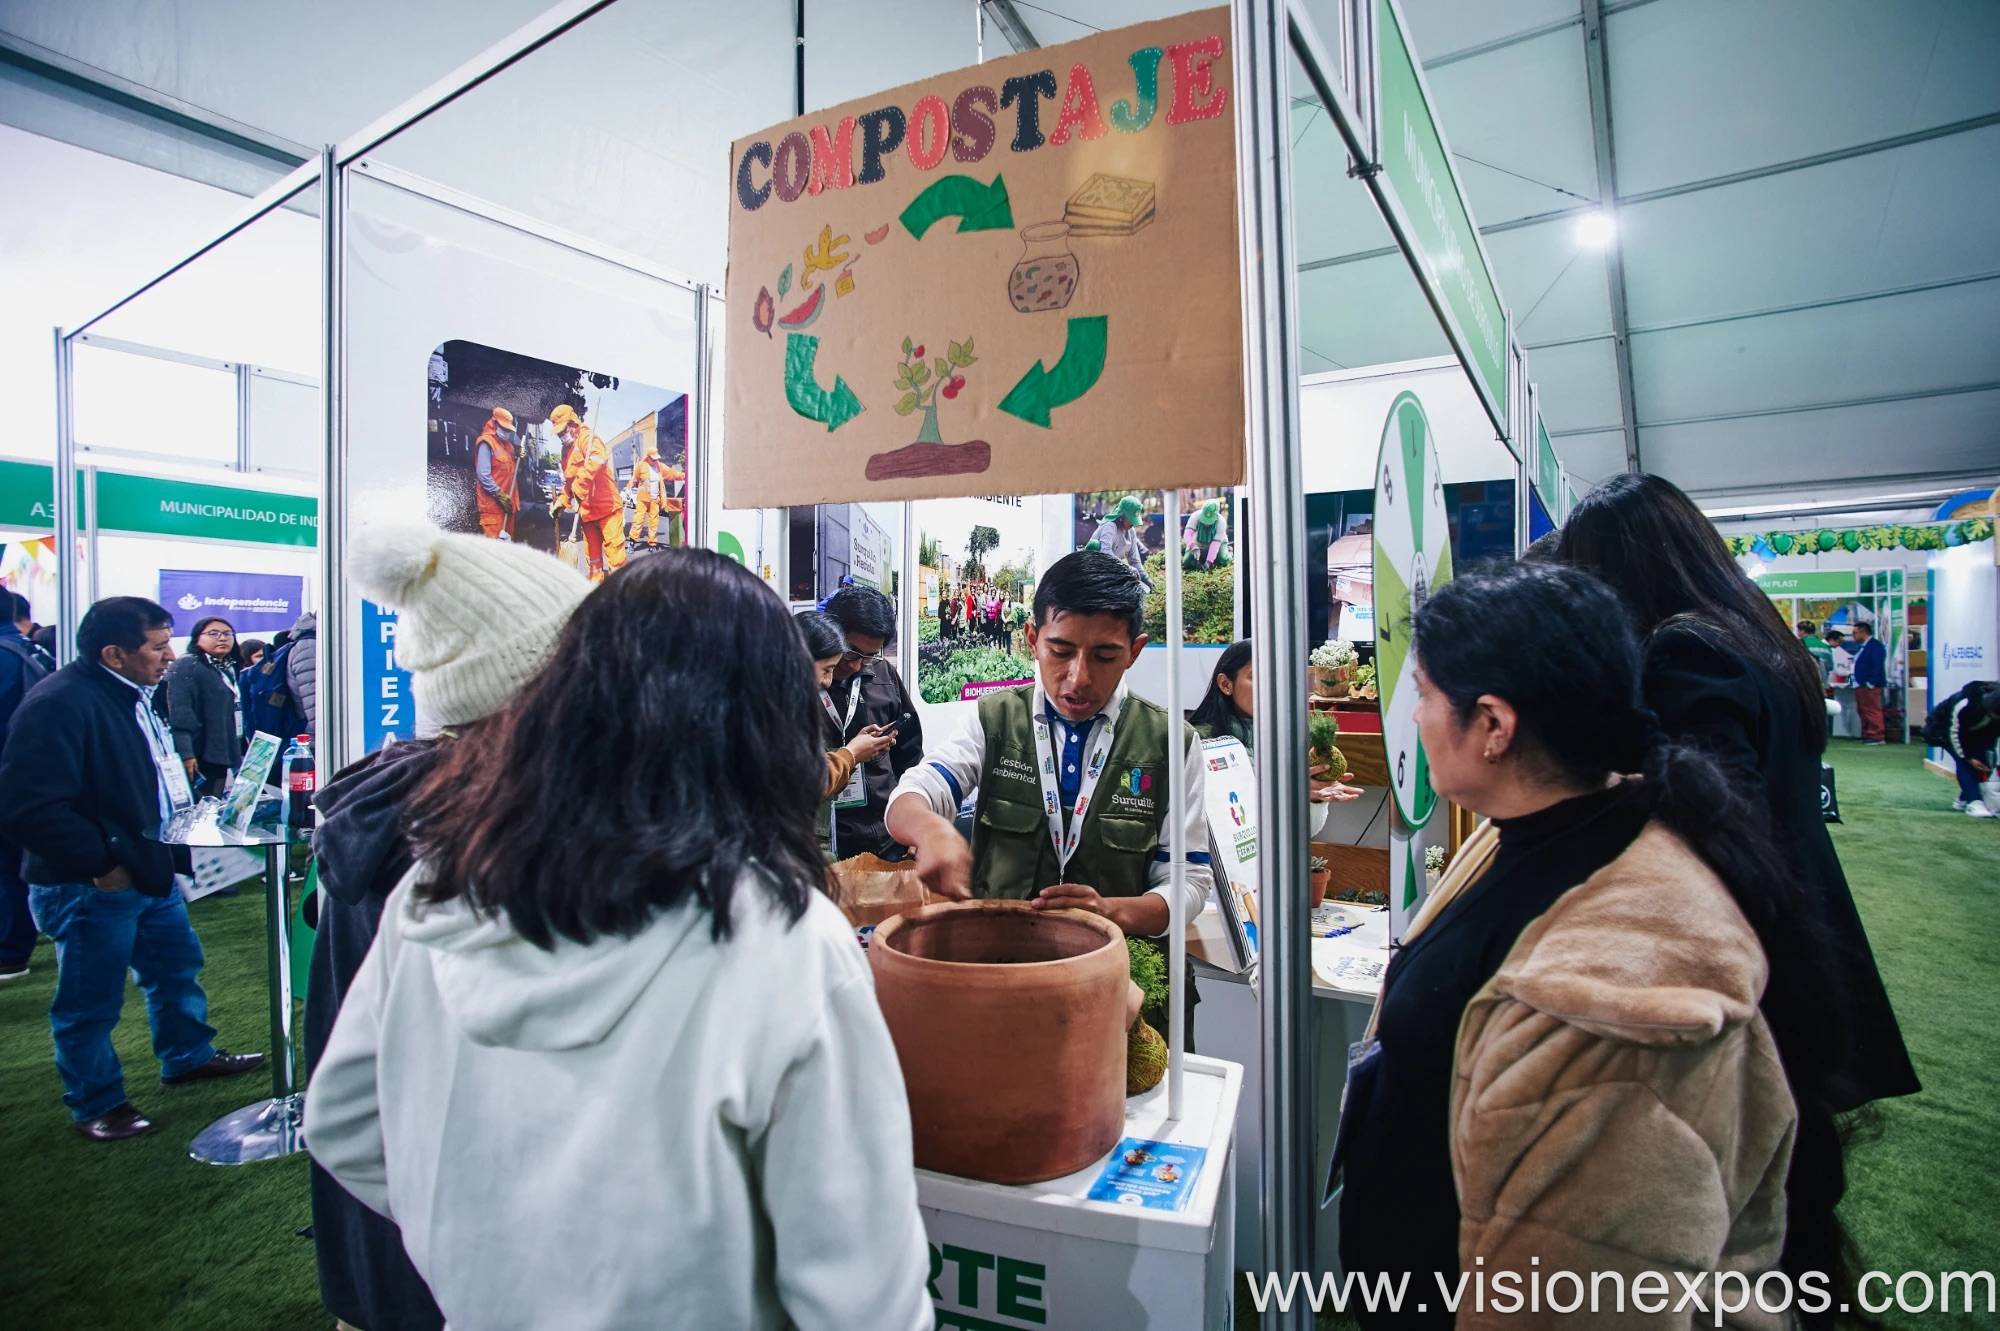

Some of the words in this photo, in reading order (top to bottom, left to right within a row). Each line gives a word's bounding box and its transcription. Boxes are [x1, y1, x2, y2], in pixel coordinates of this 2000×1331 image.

[736, 35, 1228, 211] COMPOSTAJE
[160, 500, 276, 523] MUNICIPALIDAD
[279, 513, 297, 525] DE
[1772, 580, 1798, 589] PLAST
[204, 596, 289, 611] Independencia
[1000, 756, 1033, 773] Gestión
[992, 767, 1036, 785] Ambiental
